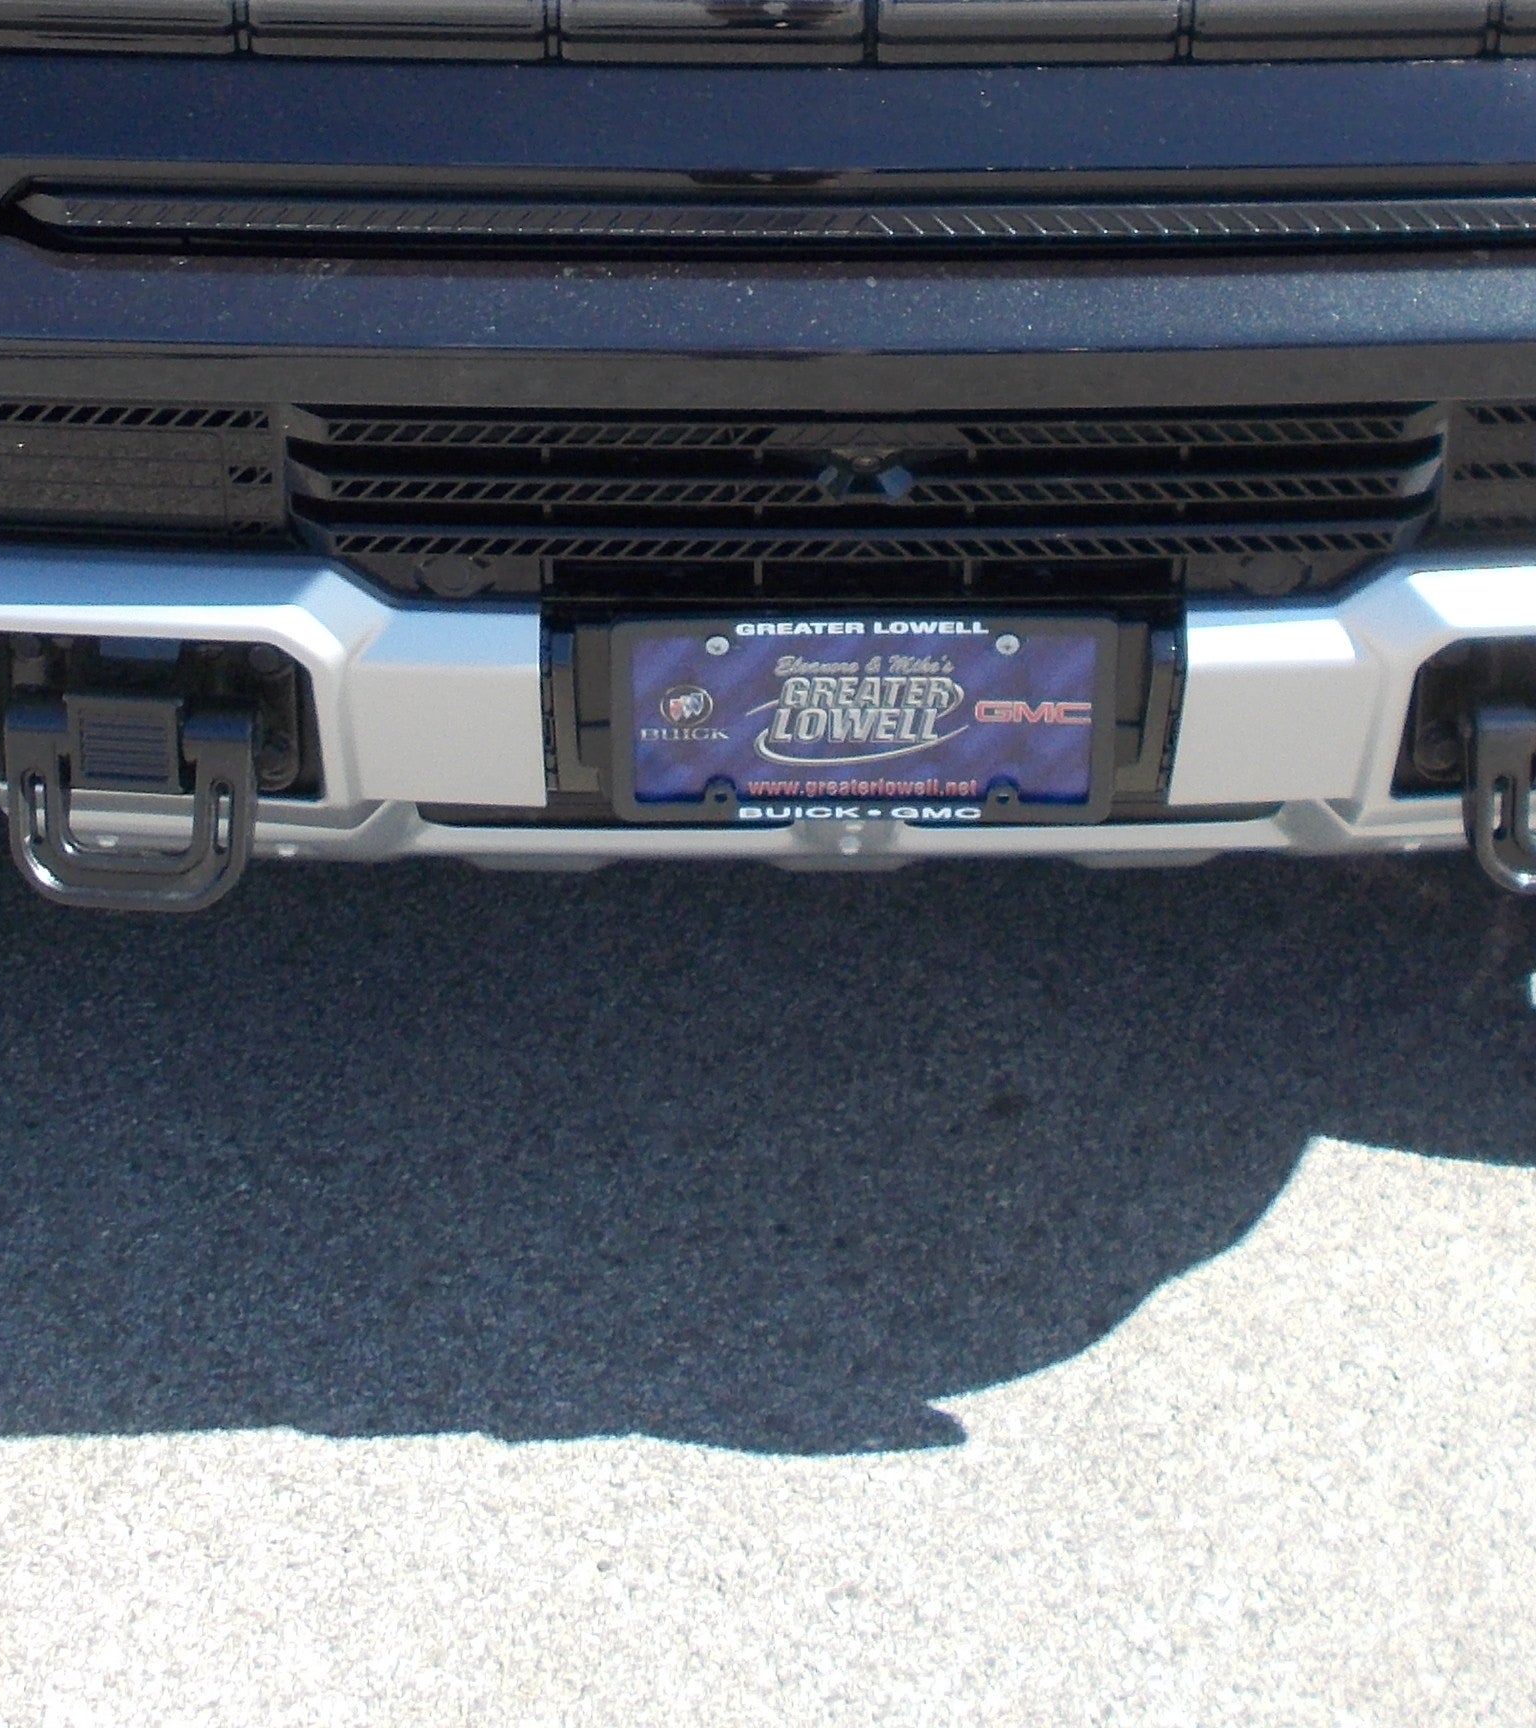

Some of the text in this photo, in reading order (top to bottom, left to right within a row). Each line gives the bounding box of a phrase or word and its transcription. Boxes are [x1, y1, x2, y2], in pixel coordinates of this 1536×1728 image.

[735, 621, 989, 636] GREATER LOWELL
[779, 677, 954, 709] GREATER
[975, 700, 1092, 724] GMC
[640, 728, 730, 741] BUICK
[769, 708, 939, 743] LOWELL
[748, 778, 978, 797] www.greaterlowell.net
[738, 806, 982, 819] BUICK GMC
